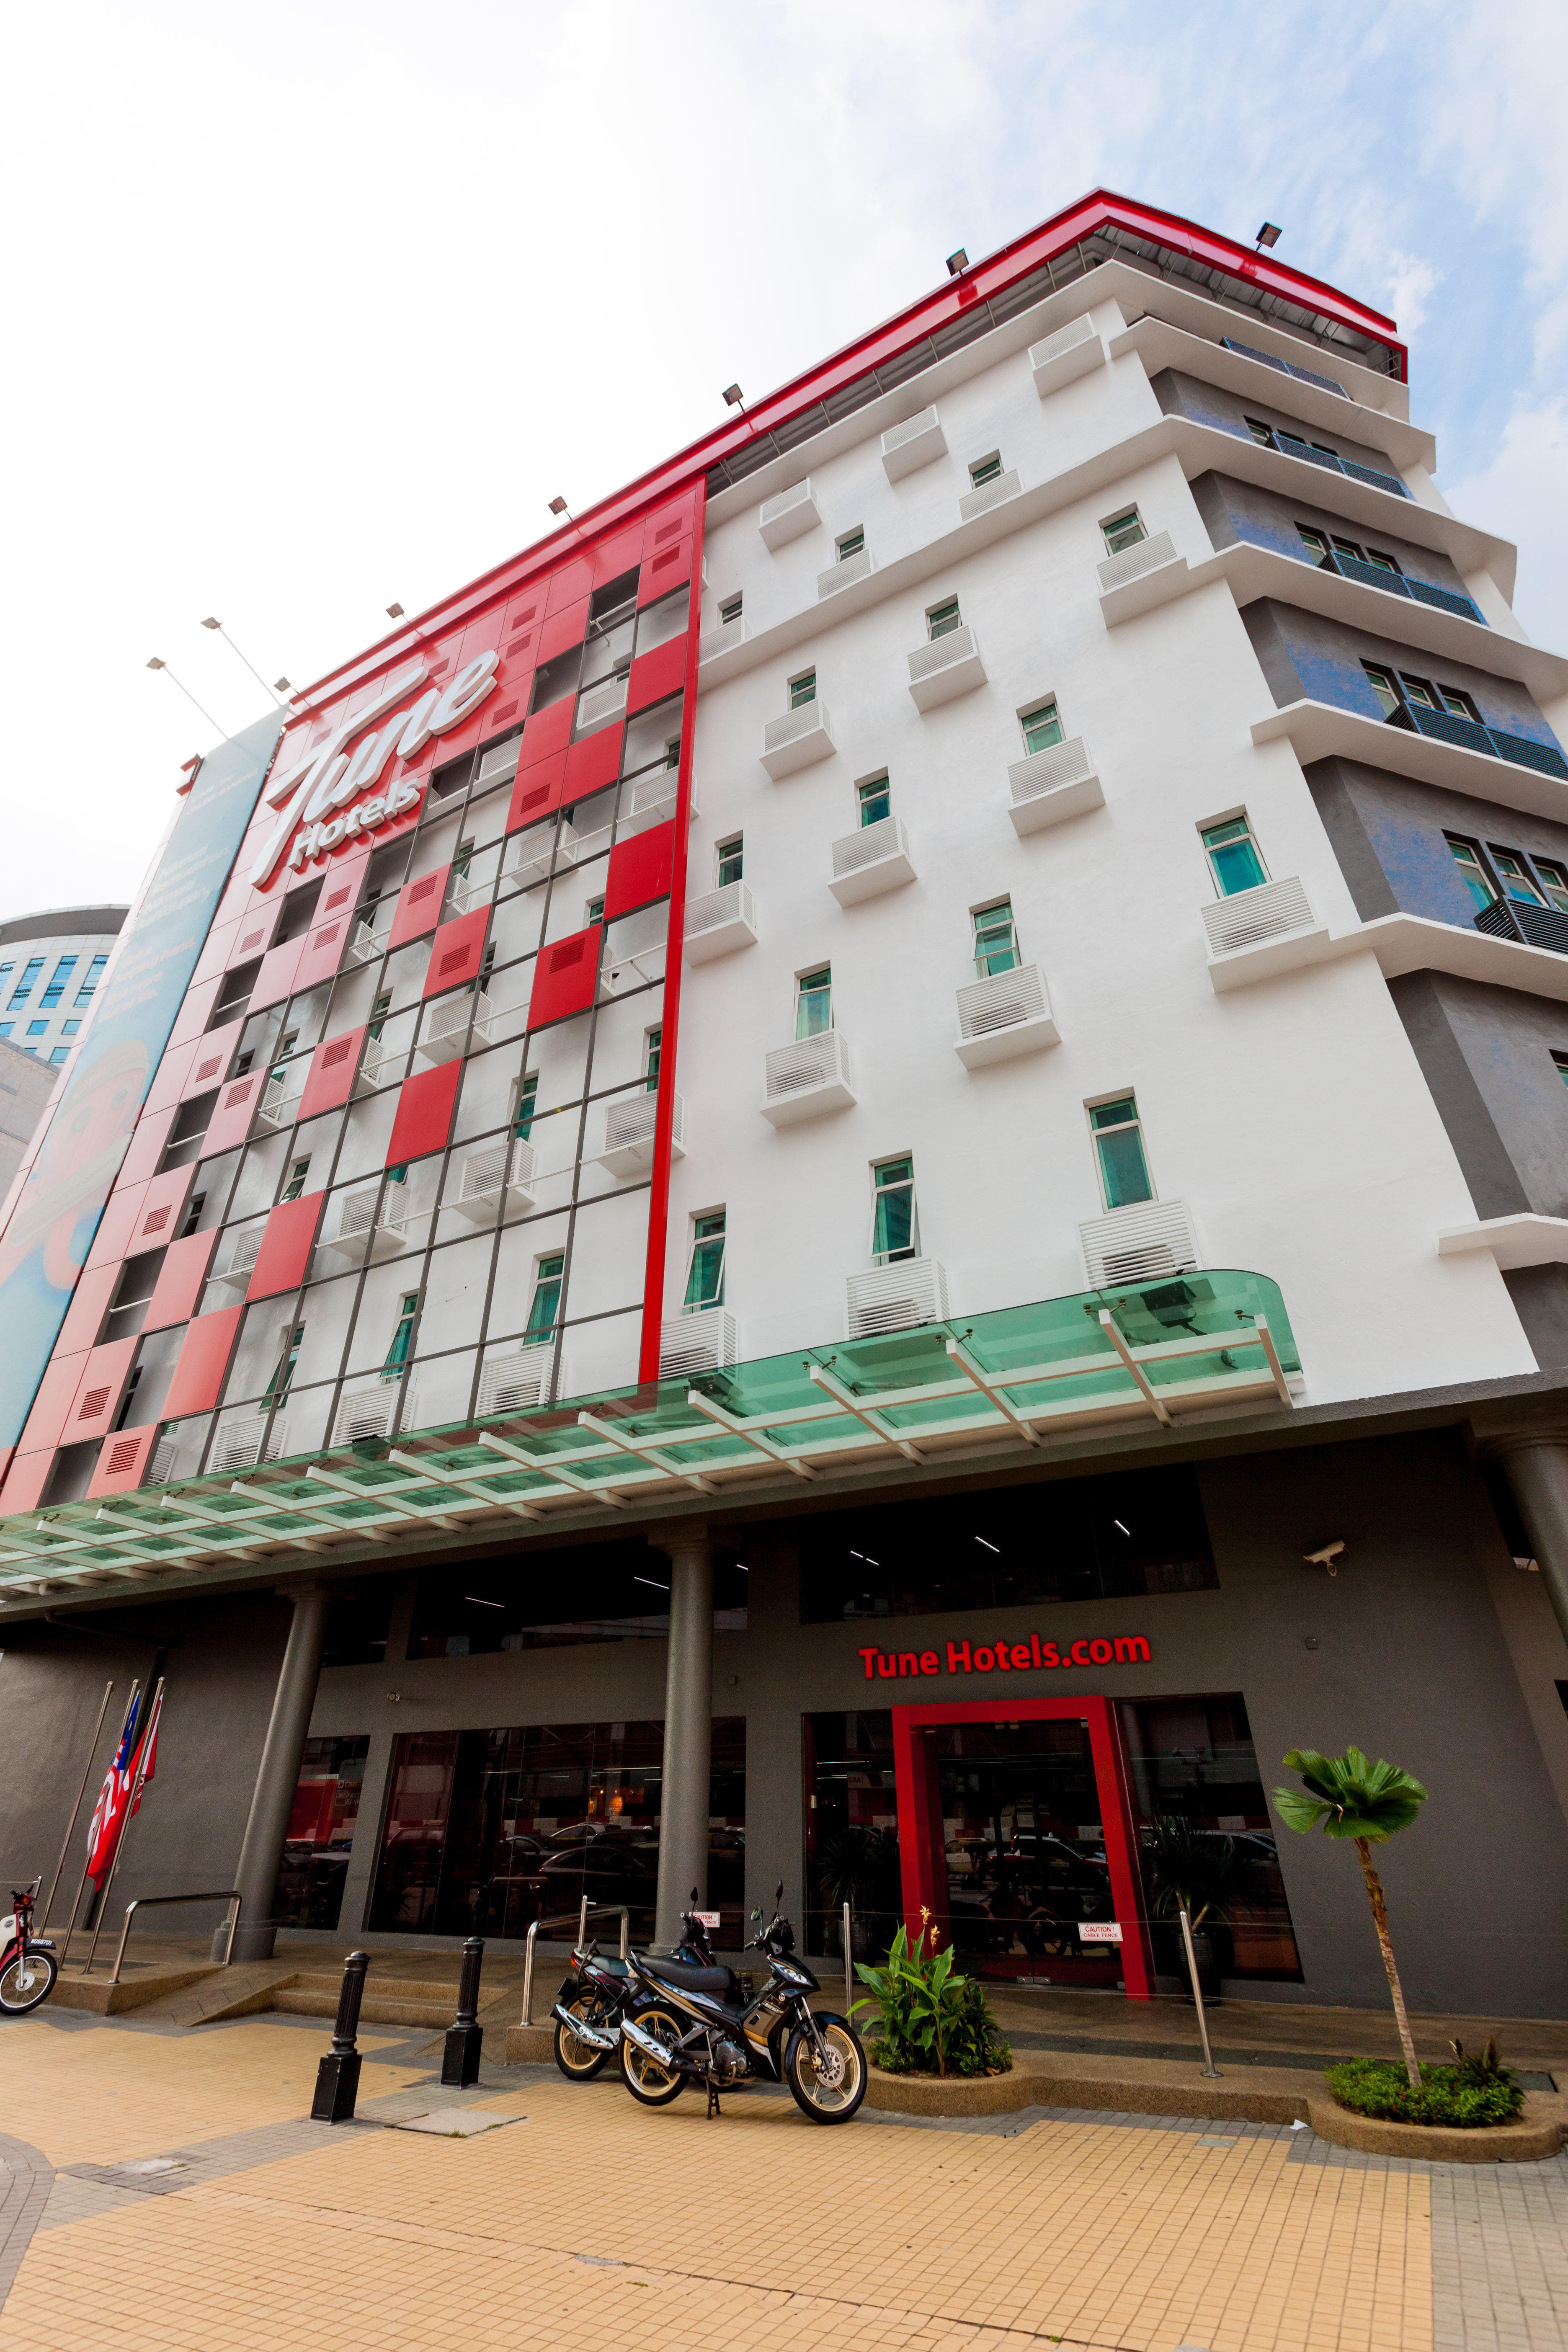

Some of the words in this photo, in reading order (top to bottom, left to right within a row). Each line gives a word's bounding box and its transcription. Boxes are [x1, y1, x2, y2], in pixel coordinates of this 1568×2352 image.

[248, 650, 499, 888] Tune
[289, 778, 422, 871] Hotels
[859, 1648, 939, 1679] Tune
[947, 1634, 1152, 1674] Hotels.com
